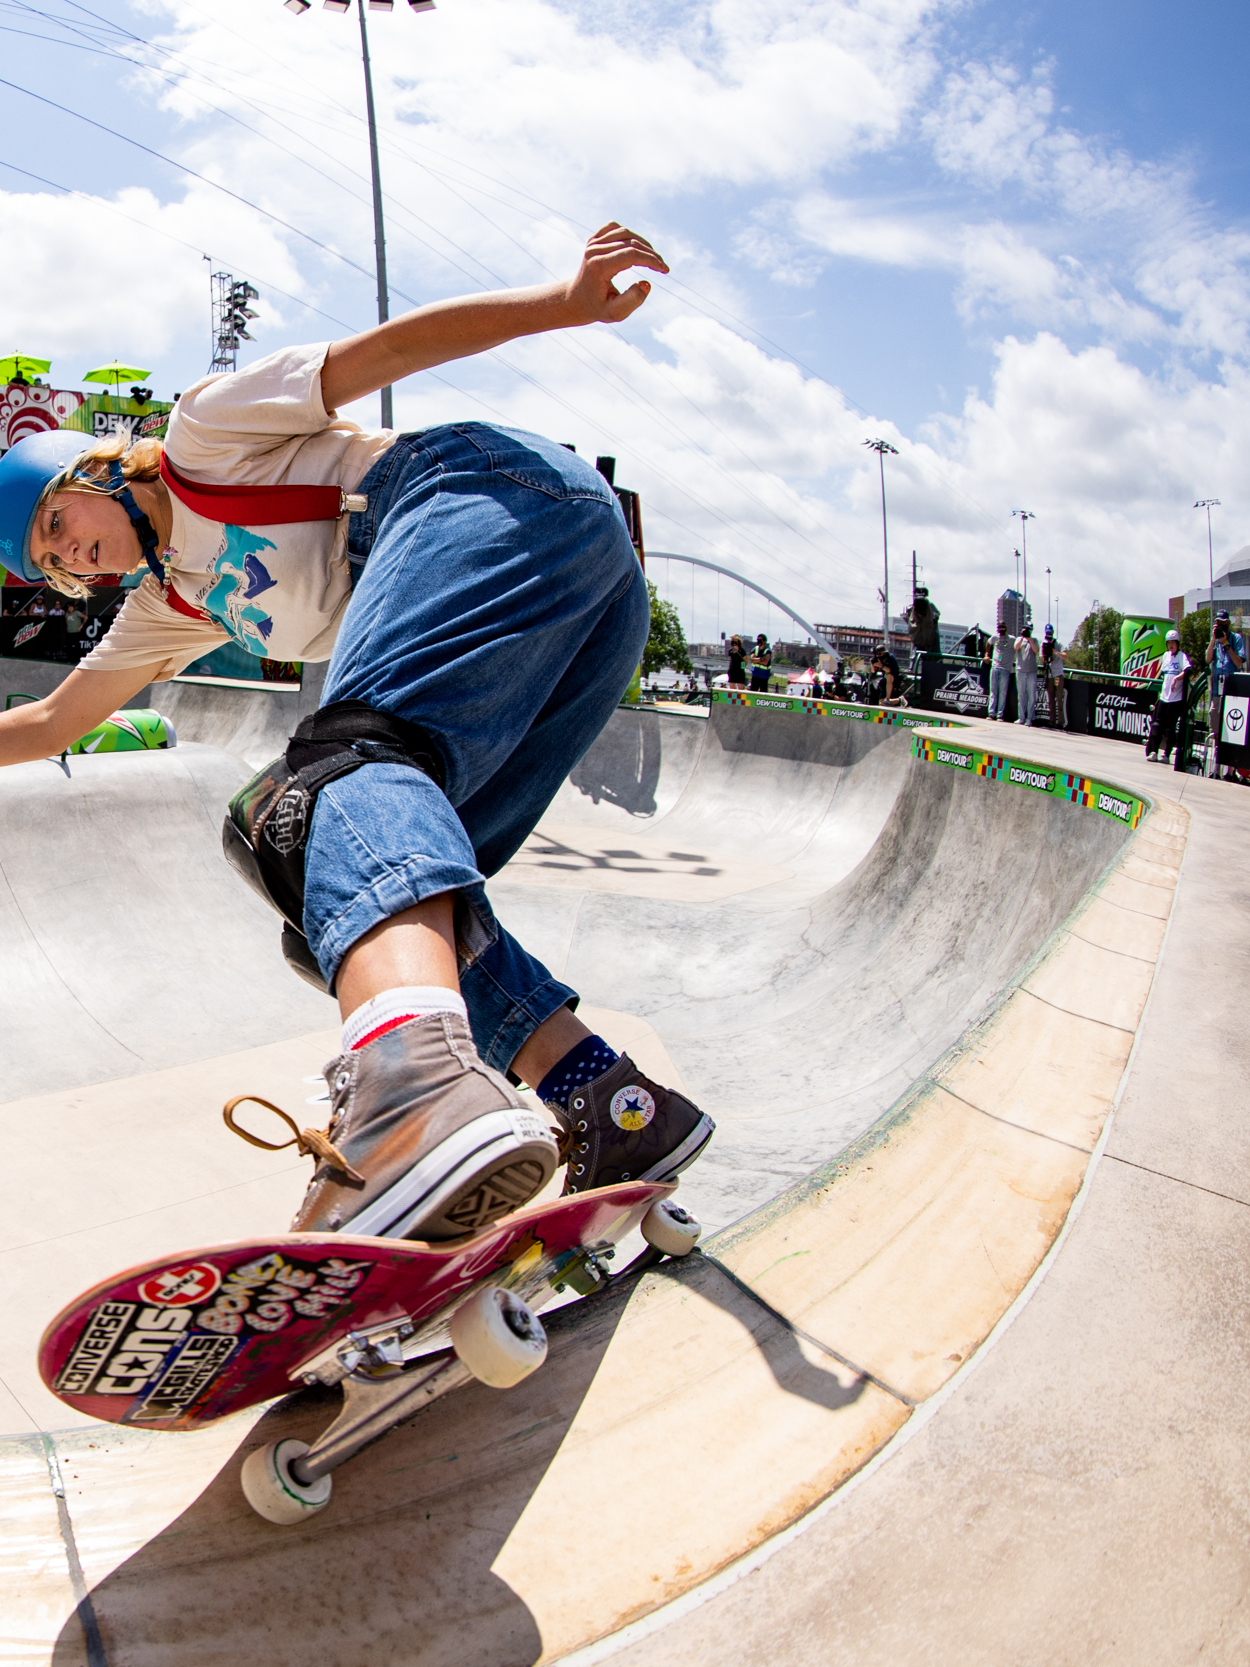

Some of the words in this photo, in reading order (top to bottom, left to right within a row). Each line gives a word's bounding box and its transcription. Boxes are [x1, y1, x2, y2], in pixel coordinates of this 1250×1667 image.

[94, 412, 140, 431] DEW
[936, 690, 958, 701] PRAIRIE
[959, 693, 988, 704] MEADOWS
[1096, 693, 1137, 708] CATCH
[1095, 706, 1115, 730] DES
[1117, 710, 1152, 737] MOINES
[614, 1089, 641, 1115] CONVERSE
[197, 1253, 284, 1335] BONES
[246, 1264, 317, 1332] LOVE
[60, 1302, 130, 1394] CONVERSE
[95, 1306, 193, 1395] CONS
